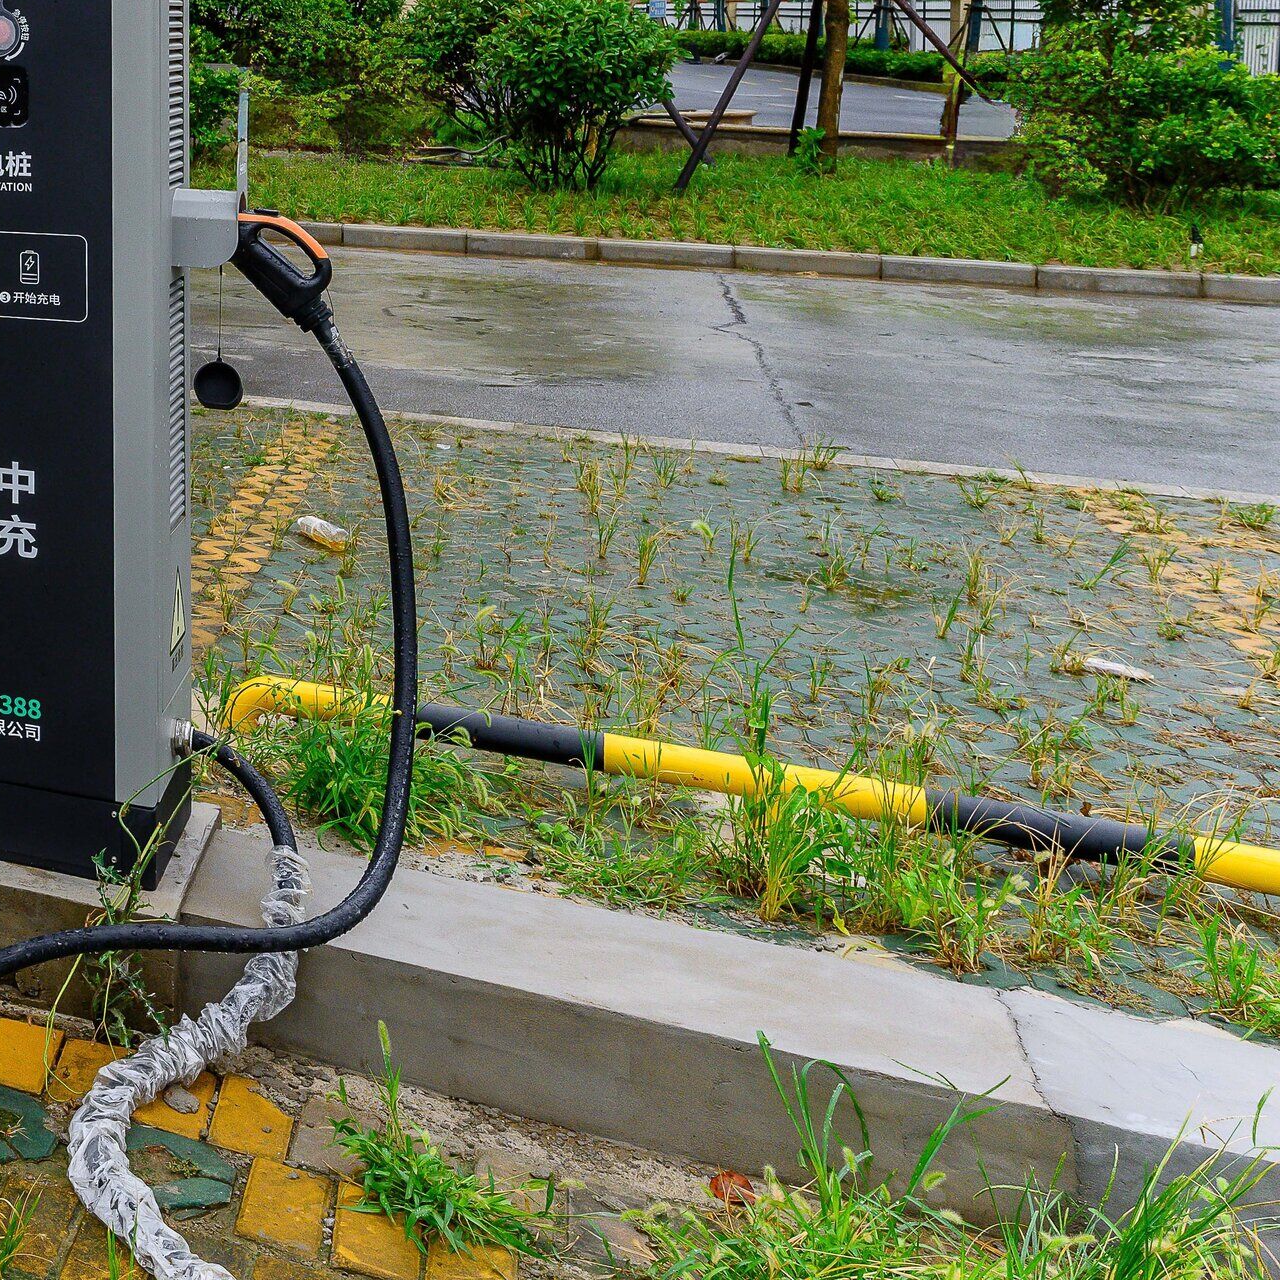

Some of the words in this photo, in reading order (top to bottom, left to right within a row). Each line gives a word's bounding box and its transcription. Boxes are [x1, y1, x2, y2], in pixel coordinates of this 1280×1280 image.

[11, 8, 30, 42] 急停按钮
[13, 292, 61, 306] 开始充电
